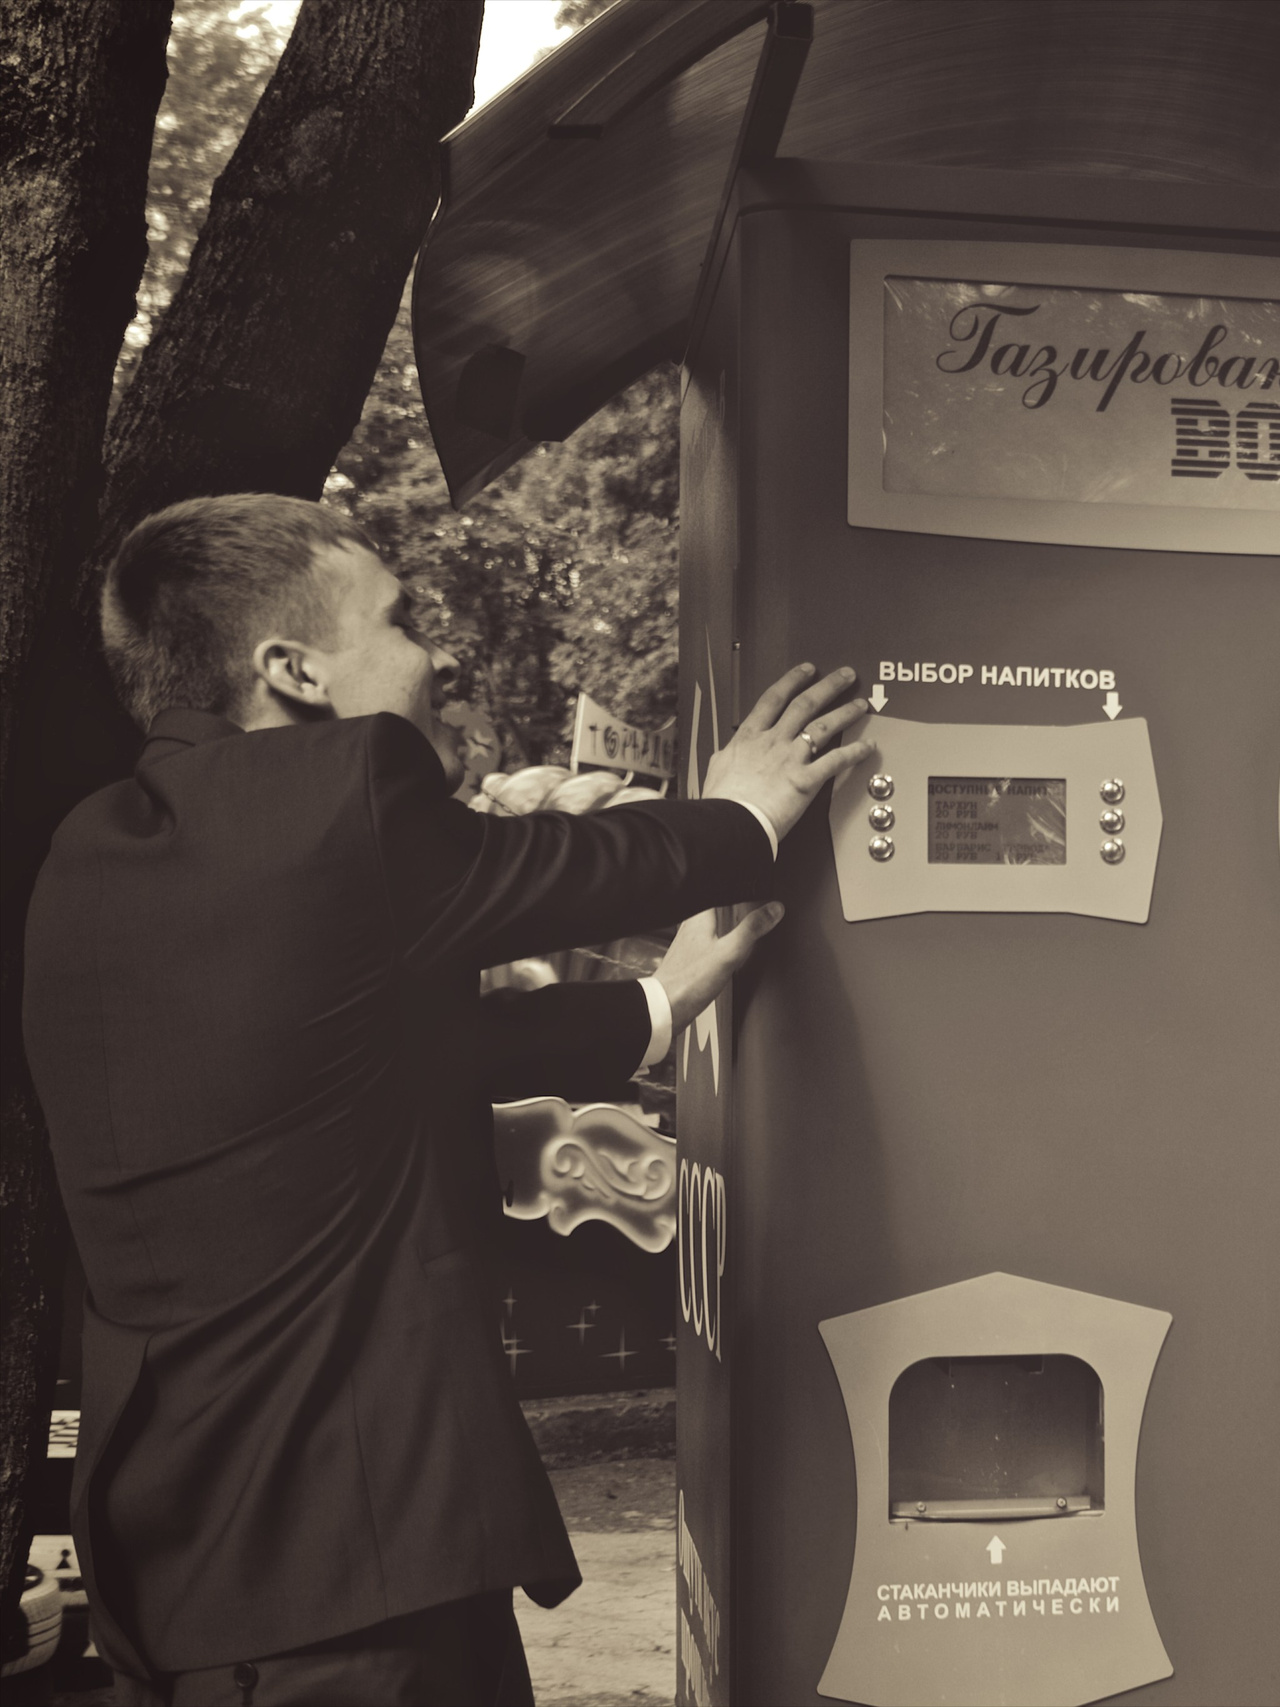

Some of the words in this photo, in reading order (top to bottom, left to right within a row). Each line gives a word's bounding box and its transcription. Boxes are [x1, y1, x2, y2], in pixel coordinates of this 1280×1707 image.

[879, 661, 974, 684] ВЫБОР
[981, 665, 1116, 690] НАПИТКОВ
[877, 1580, 1001, 1601] СТАКАНЧИКИ
[1006, 1576, 1120, 1597] ВЫПАДАЮТ
[877, 1596, 1120, 1622] АВТОМАТИЧЕСКИ
